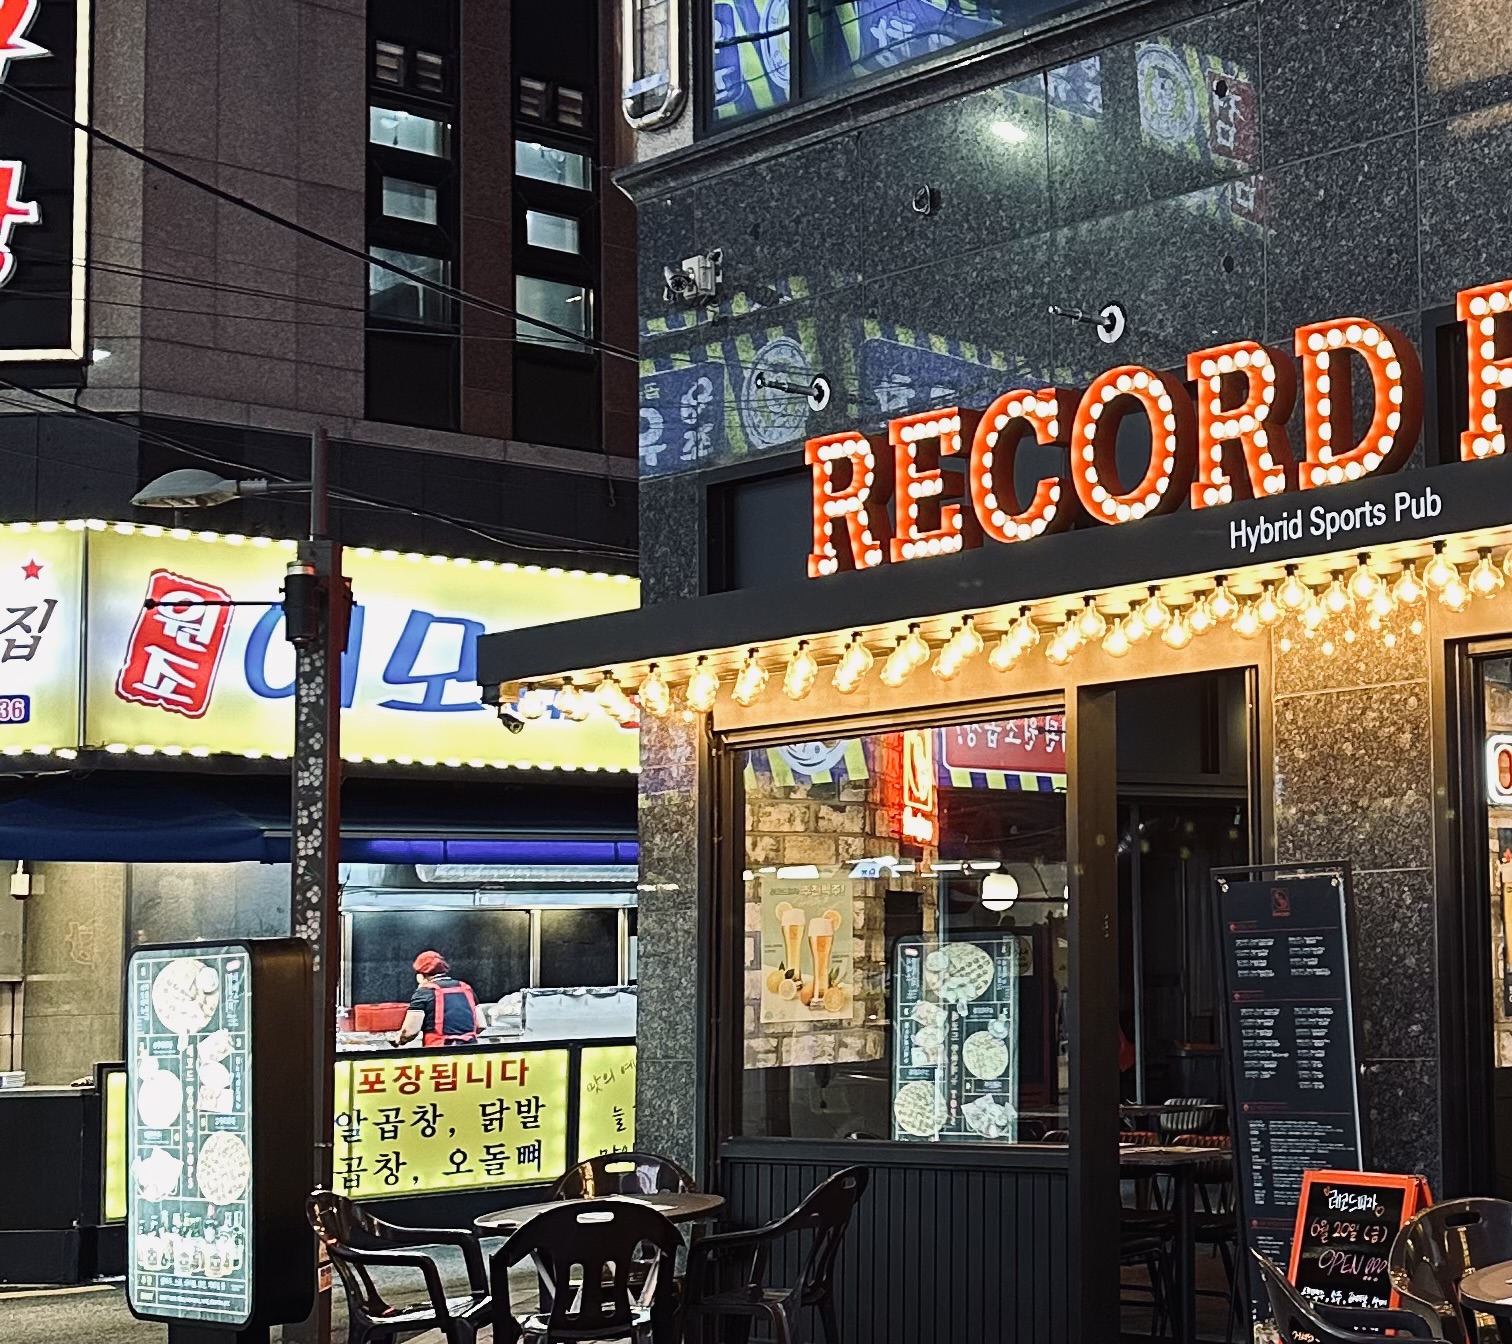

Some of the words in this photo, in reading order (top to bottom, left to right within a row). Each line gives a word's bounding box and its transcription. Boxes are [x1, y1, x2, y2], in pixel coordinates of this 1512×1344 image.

[804, 316, 1412, 578] RECORD
[1230, 509, 1303, 553] Hybrid
[1310, 501, 1387, 541] Sports
[1394, 487, 1442, 522] Pub
[0, 599, 58, 663] 집
[132, 590, 221, 704] 원조
[357, 1057, 530, 1096] 포장됩니다
[479, 1096, 546, 1133] 닭발
[442, 1139, 542, 1176] 오돌뼈
[1310, 1217, 1330, 1244] 6월
[1332, 1221, 1360, 1242] 20일
[1318, 1249, 1365, 1277] OPEN
